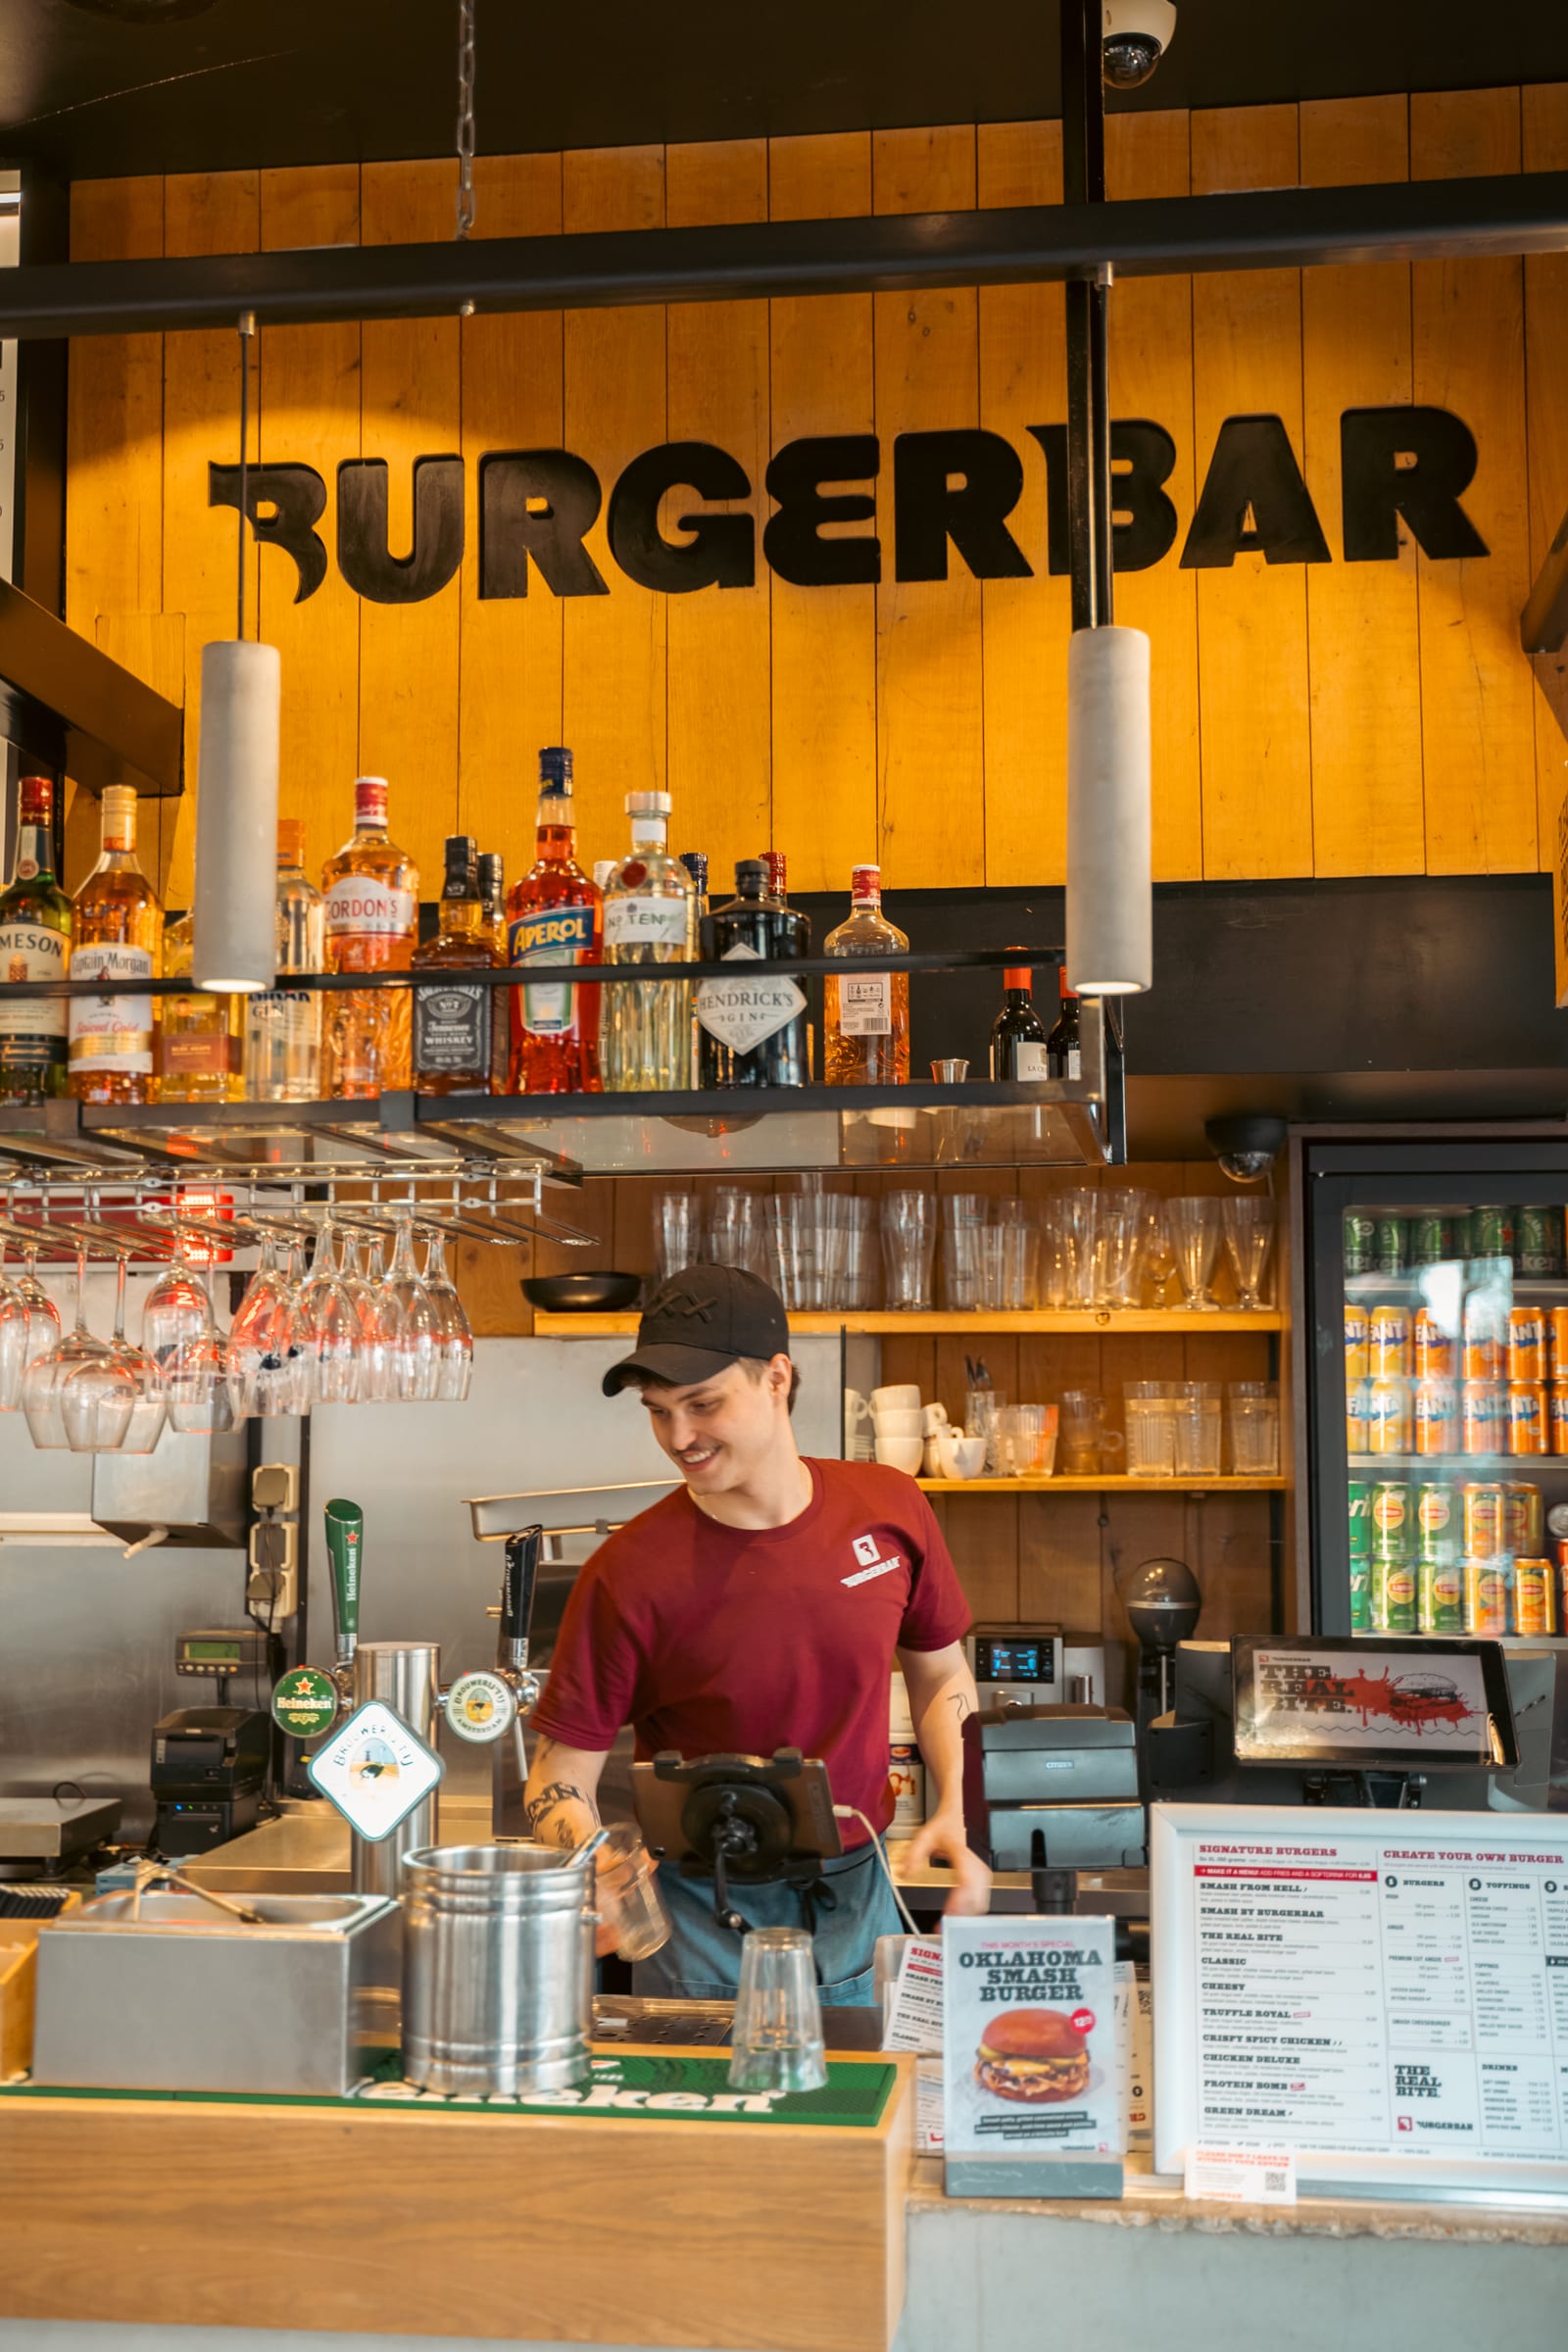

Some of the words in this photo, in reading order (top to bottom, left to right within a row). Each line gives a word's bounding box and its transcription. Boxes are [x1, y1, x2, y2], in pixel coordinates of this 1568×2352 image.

[208, 405, 1491, 604] BURGERBAR
[513, 917, 587, 956] APEROL
[700, 991, 794, 1010] HENDRICK'S
[424, 1036, 473, 1046] WHISKEY
[346, 1547, 358, 1601] Heineken
[1259, 1664, 1331, 1680] THE
[1260, 1680, 1355, 1696] REAL
[276, 1696, 332, 1709] Heineken
[1199, 1844, 1273, 1855] SIGNATURE
[1276, 1846, 1338, 1857] BURGERS
[1384, 1849, 1436, 1860] CREATE
[1438, 1851, 1473, 1861] YOUR
[1476, 1852, 1506, 1862] OWN
[1508, 1854, 1564, 1864] BURGER
[1200, 1882, 1238, 1890] SMASH
[1273, 1884, 1302, 1892] HELL
[1402, 1879, 1445, 1887] BURGERS
[1241, 1907, 1254, 1916] BY
[1256, 1908, 1325, 1918] BURGERBAR
[1256, 1934, 1284, 1942] BITE
[910, 1947, 943, 1961] SIGN
[958, 1949, 1103, 1969] OKLAHOMA
[1201, 1957, 1247, 1966] CLASSIC
[987, 1968, 1078, 1985] SMASH
[1201, 1982, 1246, 1991] CHEESY
[979, 1984, 1084, 2002] BURGER
[1202, 2008, 1252, 2018] TRUFFLE
[1254, 2009, 1292, 2019] ROYAL
[1246, 2034, 1278, 2044] SPICY
[1280, 2036, 1331, 2046] CHICKEN
[1203, 2053, 1254, 2062] CHICKEN
[1256, 2055, 1301, 2065] DELUXE
[1395, 2064, 1431, 2076] THE
[1203, 2080, 1253, 2089] PROTEIN
[1256, 2082, 1288, 2090] BOMB
[1396, 2076, 1443, 2087] REAL
[1396, 2086, 1441, 2098] BITE.
[1204, 2106, 1244, 2115] GREEN
[1246, 2107, 1287, 2117] DREAM
